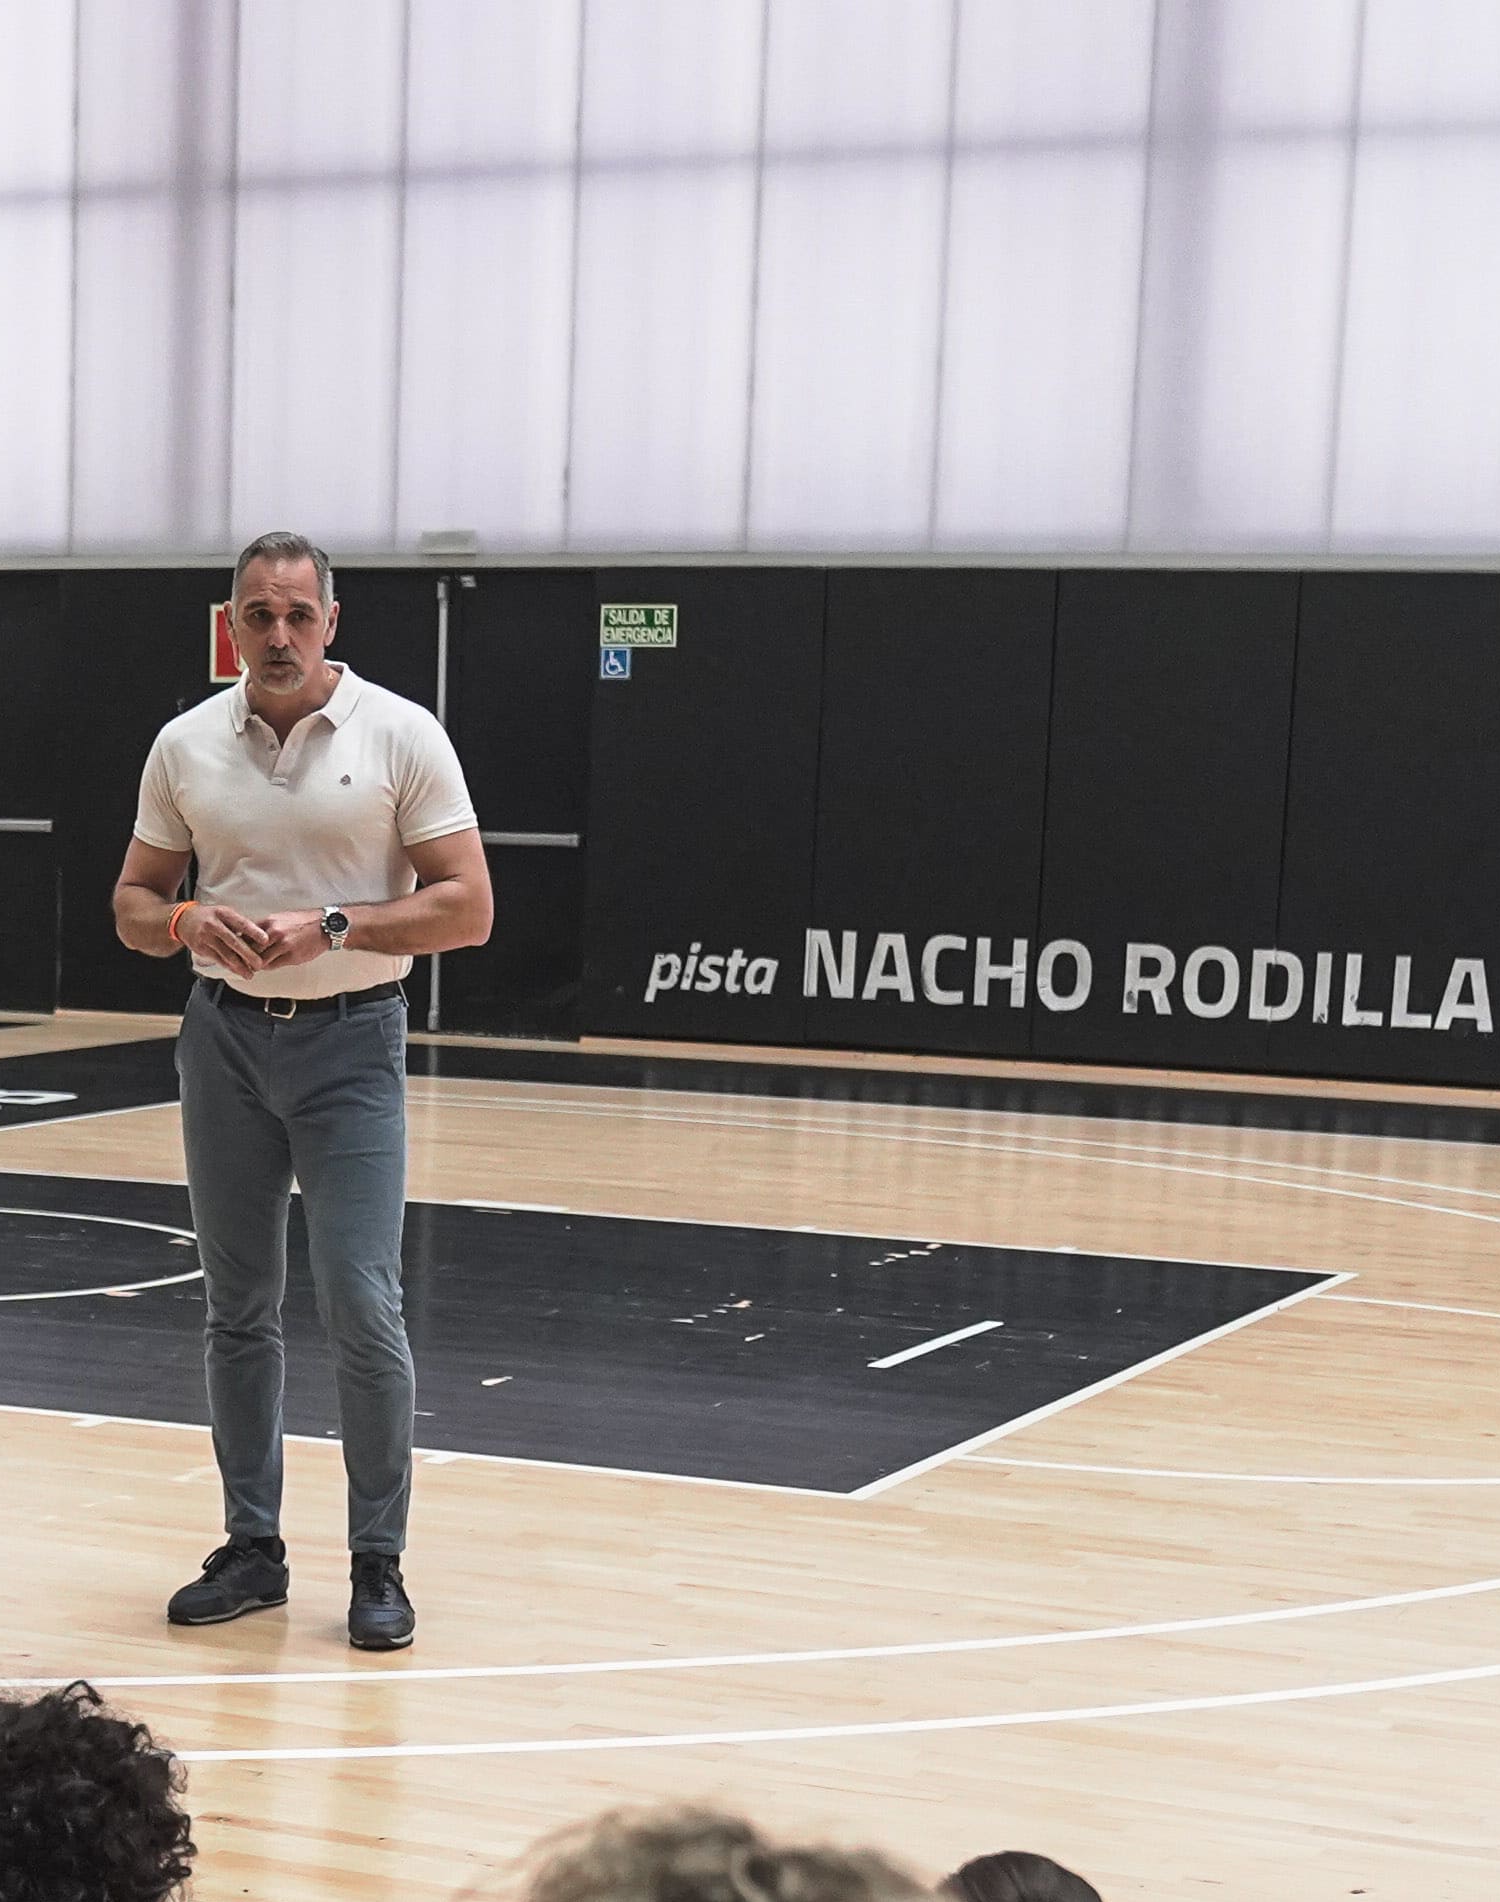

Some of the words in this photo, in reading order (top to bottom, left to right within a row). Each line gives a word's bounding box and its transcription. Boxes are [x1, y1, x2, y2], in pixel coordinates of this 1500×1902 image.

[608, 609, 646, 625] SALIDA
[654, 609, 670, 625] DE
[603, 626, 672, 643] EMERGENCIA
[645, 941, 779, 1002] pista
[802, 927, 1092, 1012] NACHO
[1121, 942, 1494, 1033] RODILLA
